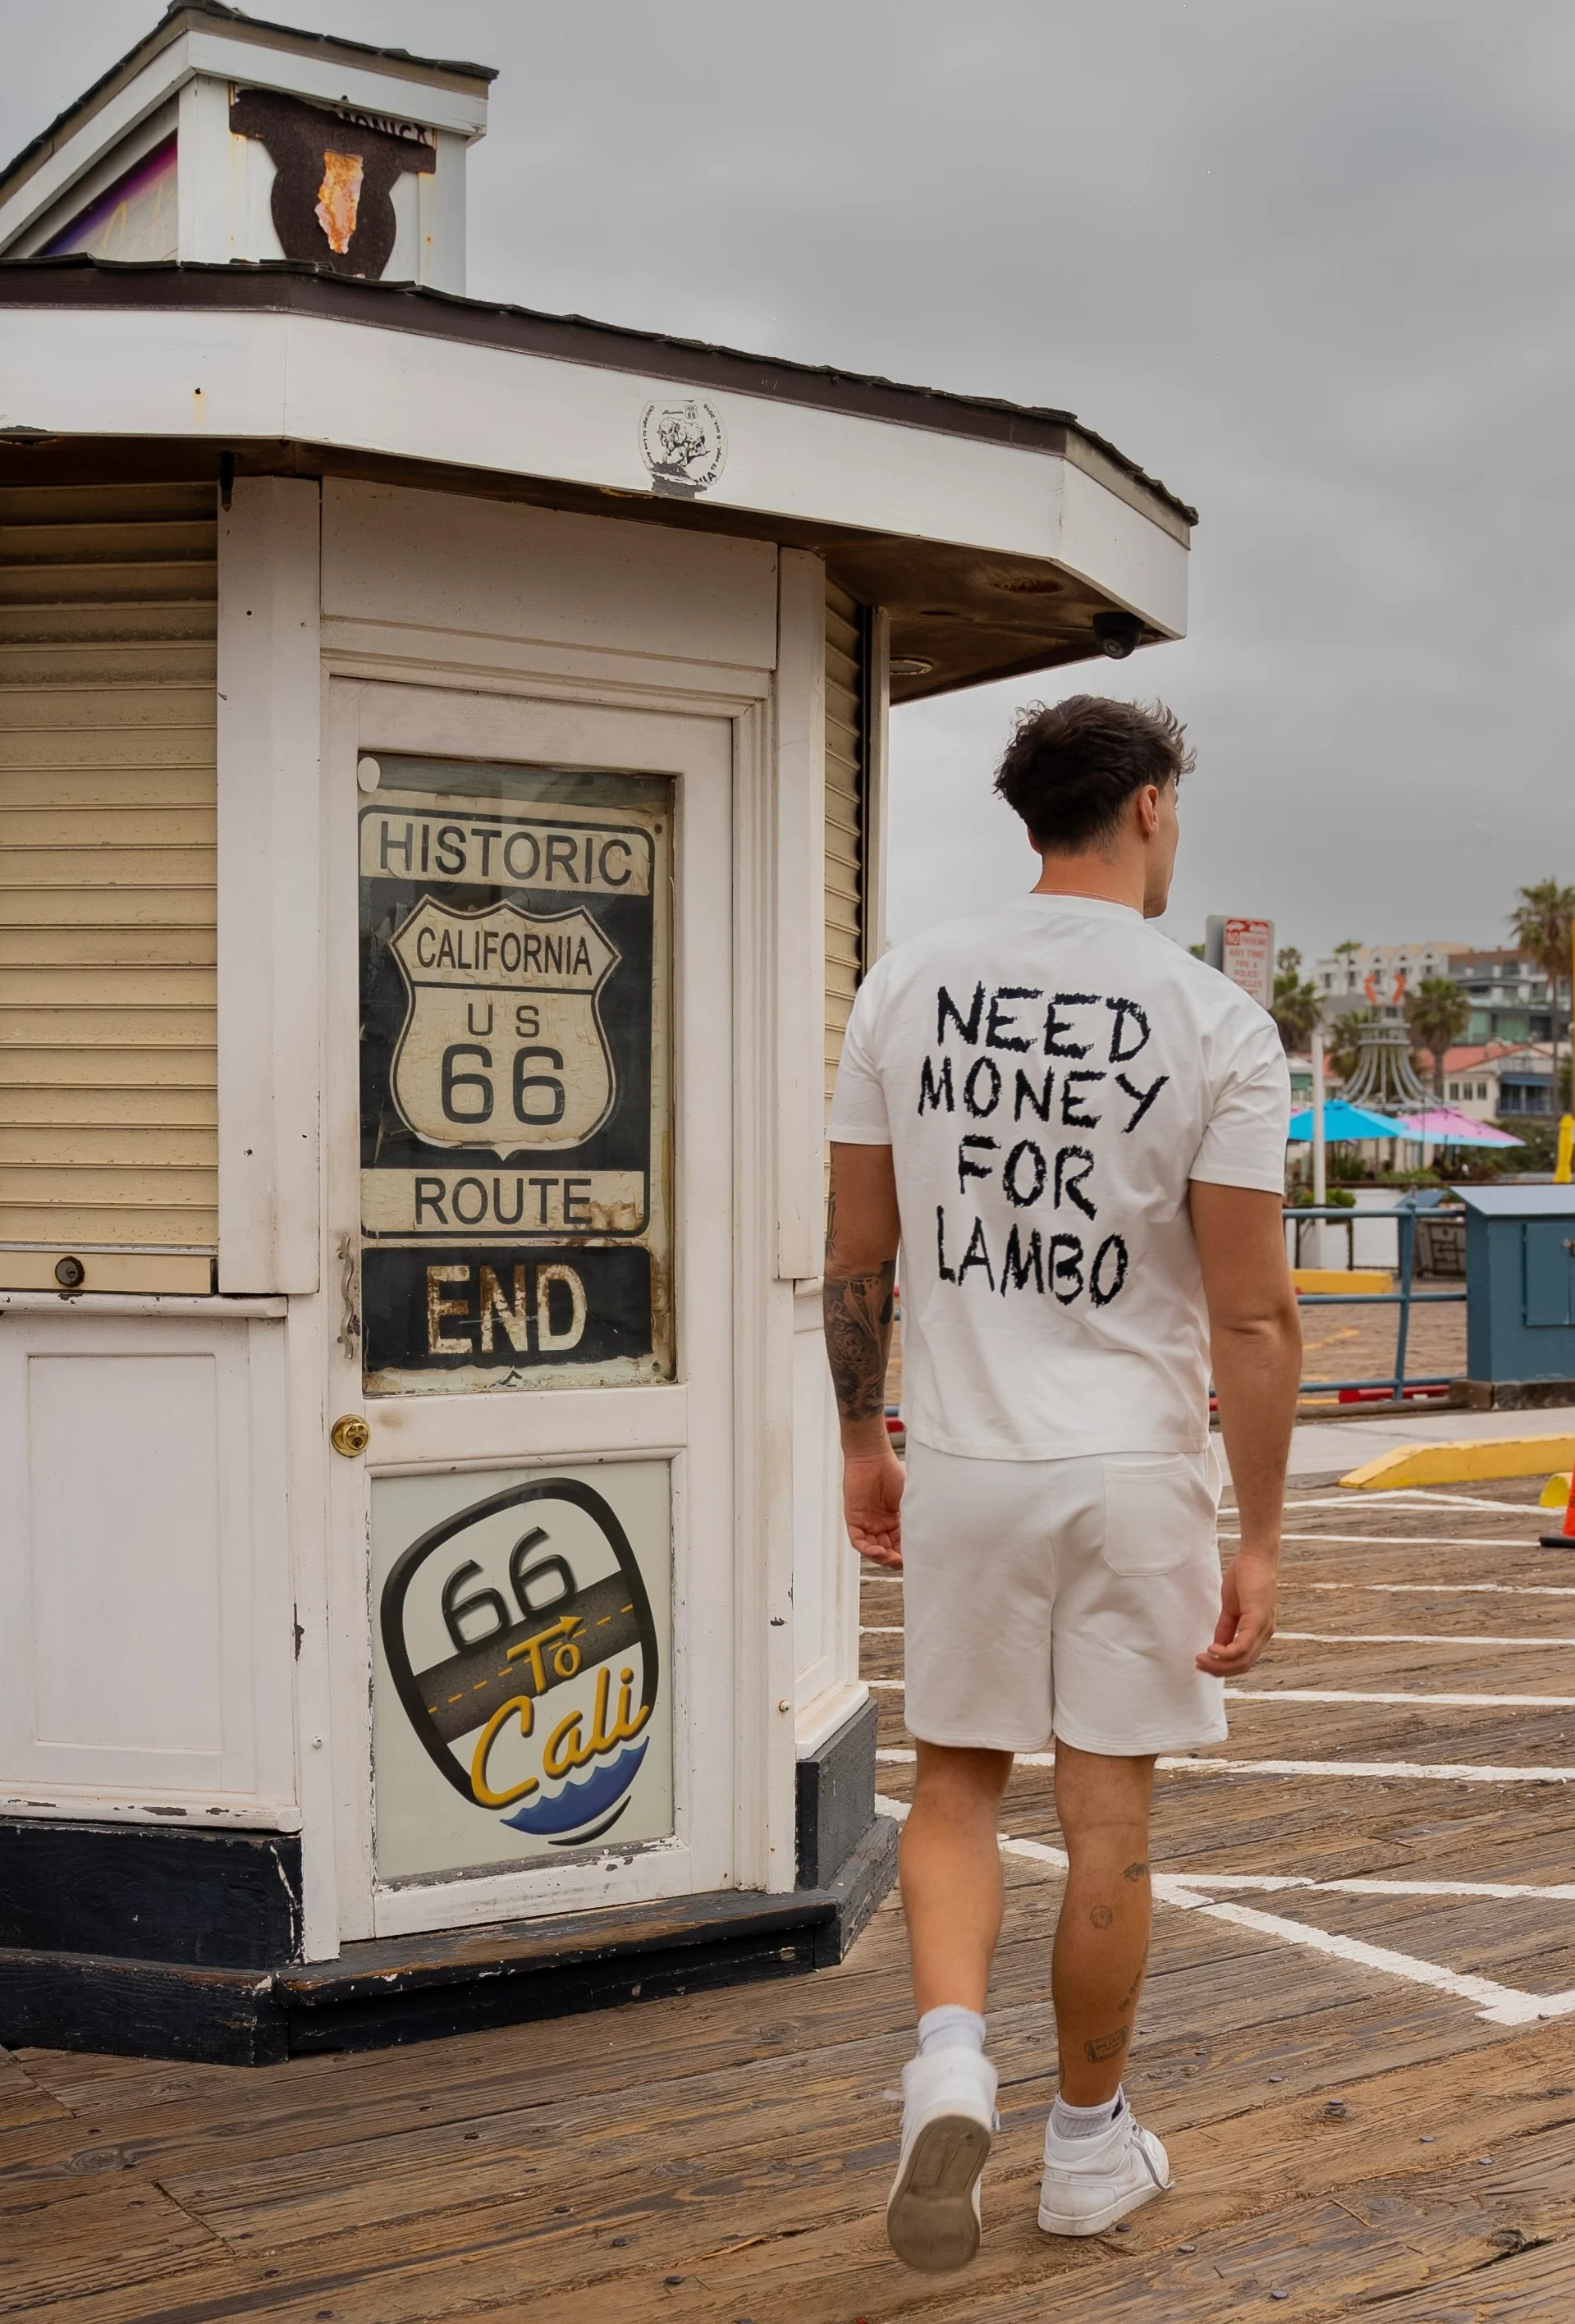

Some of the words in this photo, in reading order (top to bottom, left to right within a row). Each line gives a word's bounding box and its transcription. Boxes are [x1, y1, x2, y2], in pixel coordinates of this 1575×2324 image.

[379, 819, 632, 888] HISTORIC
[416, 926, 593, 977] CALIFORNIA
[936, 980, 1151, 1064] NEED
[441, 1044, 565, 1127] 66
[918, 1054, 1170, 1133] MONEY
[414, 1176, 592, 1225] ROUTE
[958, 1134, 1098, 1221] FOR
[936, 1205, 1129, 1308] LAMBO
[427, 1263, 587, 1354] END
[441, 1526, 576, 1654] 66
[506, 1615, 584, 1695] To
[471, 1667, 649, 1810] Cali
